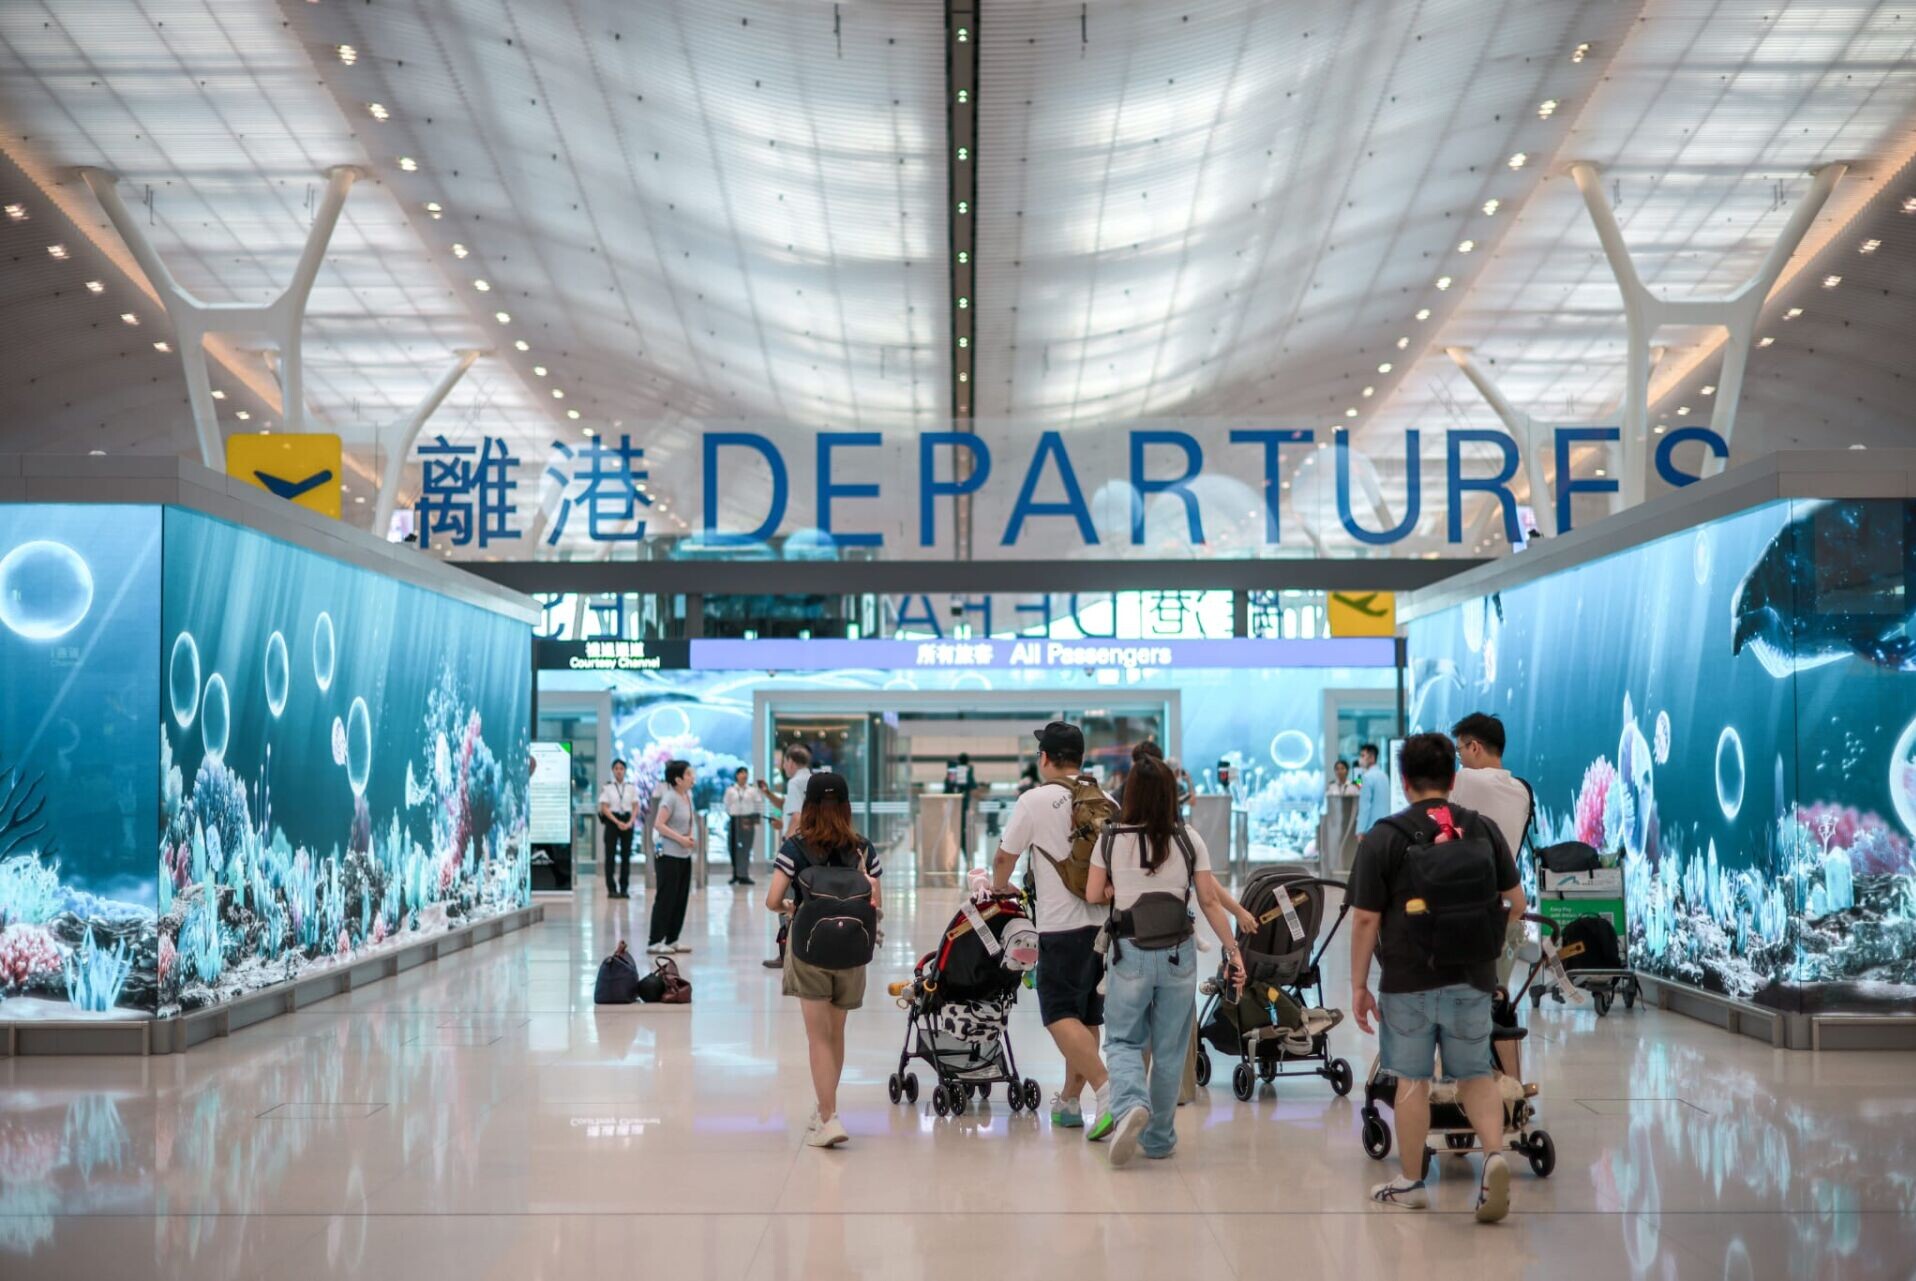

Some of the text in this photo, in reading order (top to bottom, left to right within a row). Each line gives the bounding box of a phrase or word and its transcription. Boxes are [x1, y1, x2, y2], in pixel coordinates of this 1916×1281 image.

[415, 435, 653, 548] 離港
[618, 656, 661, 669] Channel
[1009, 643, 1172, 668] All Passengers
